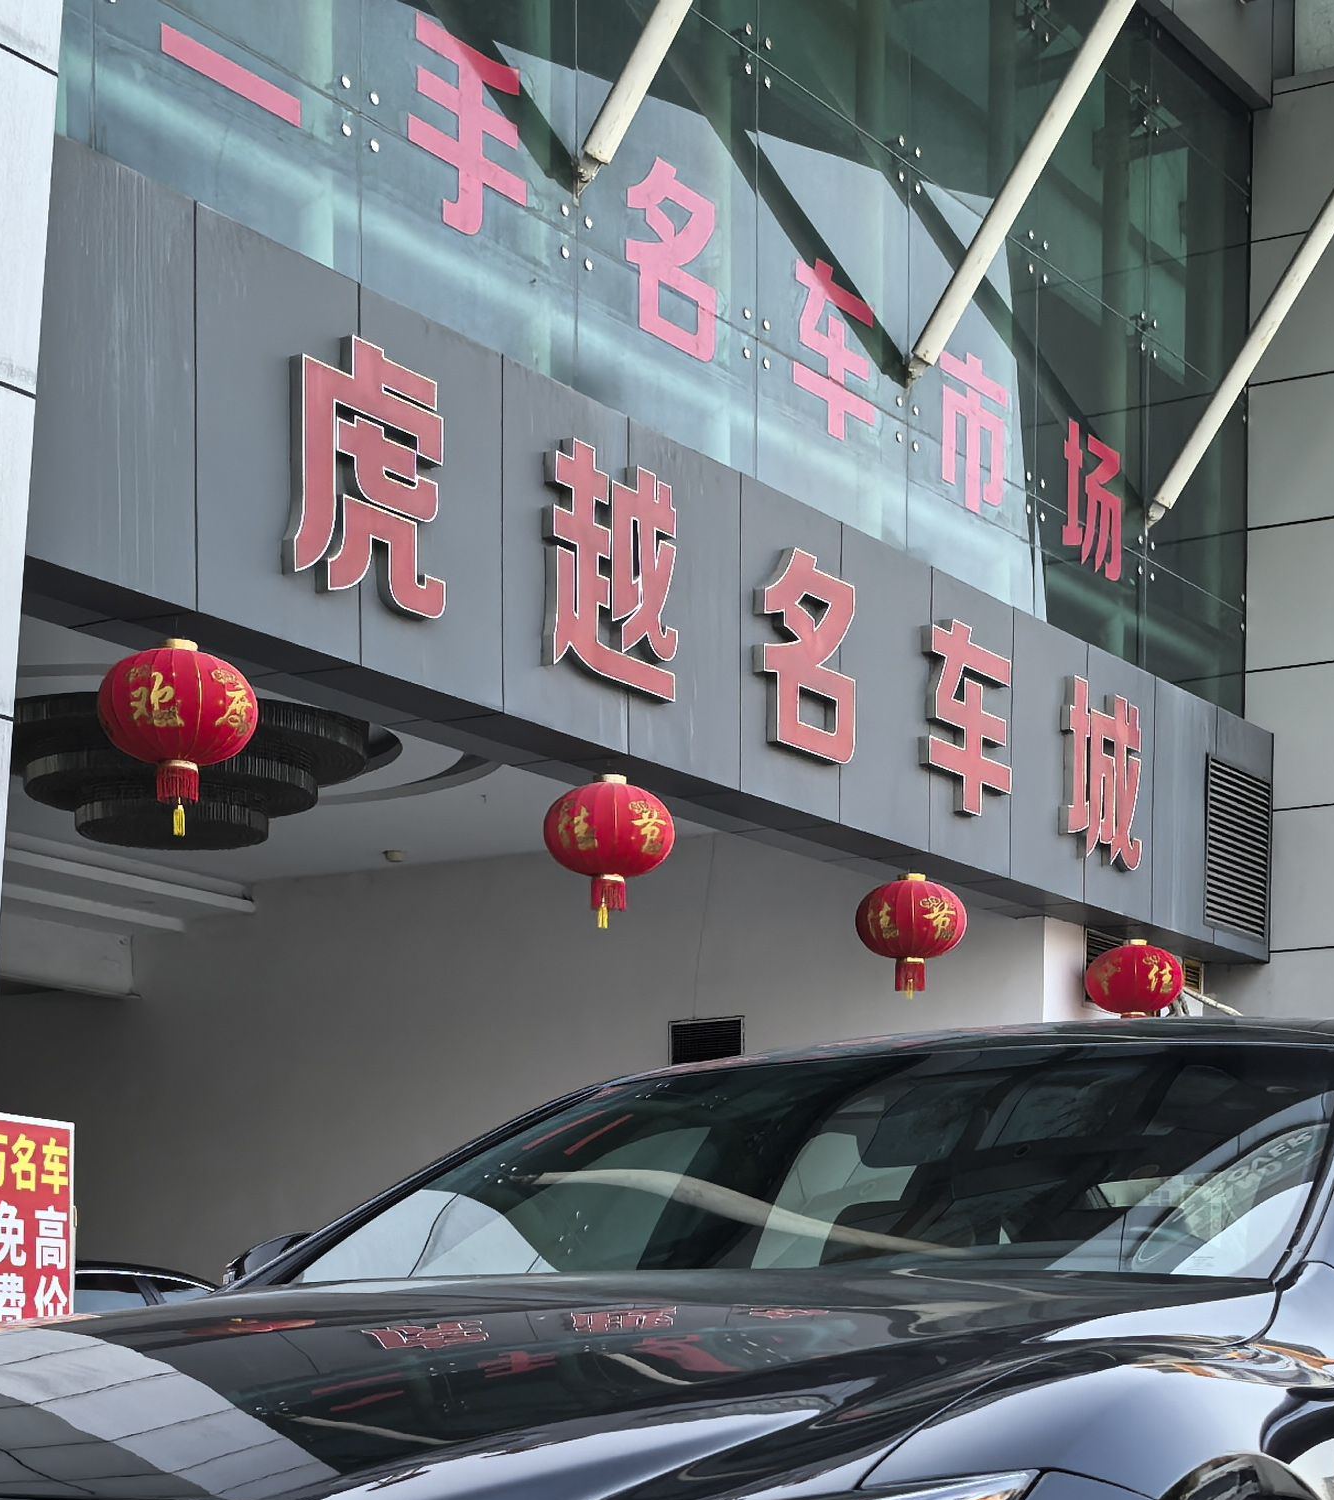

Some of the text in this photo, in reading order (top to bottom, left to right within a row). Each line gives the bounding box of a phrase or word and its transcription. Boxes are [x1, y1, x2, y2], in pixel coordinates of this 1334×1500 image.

[284, 334, 1143, 871] 虎越名车城
